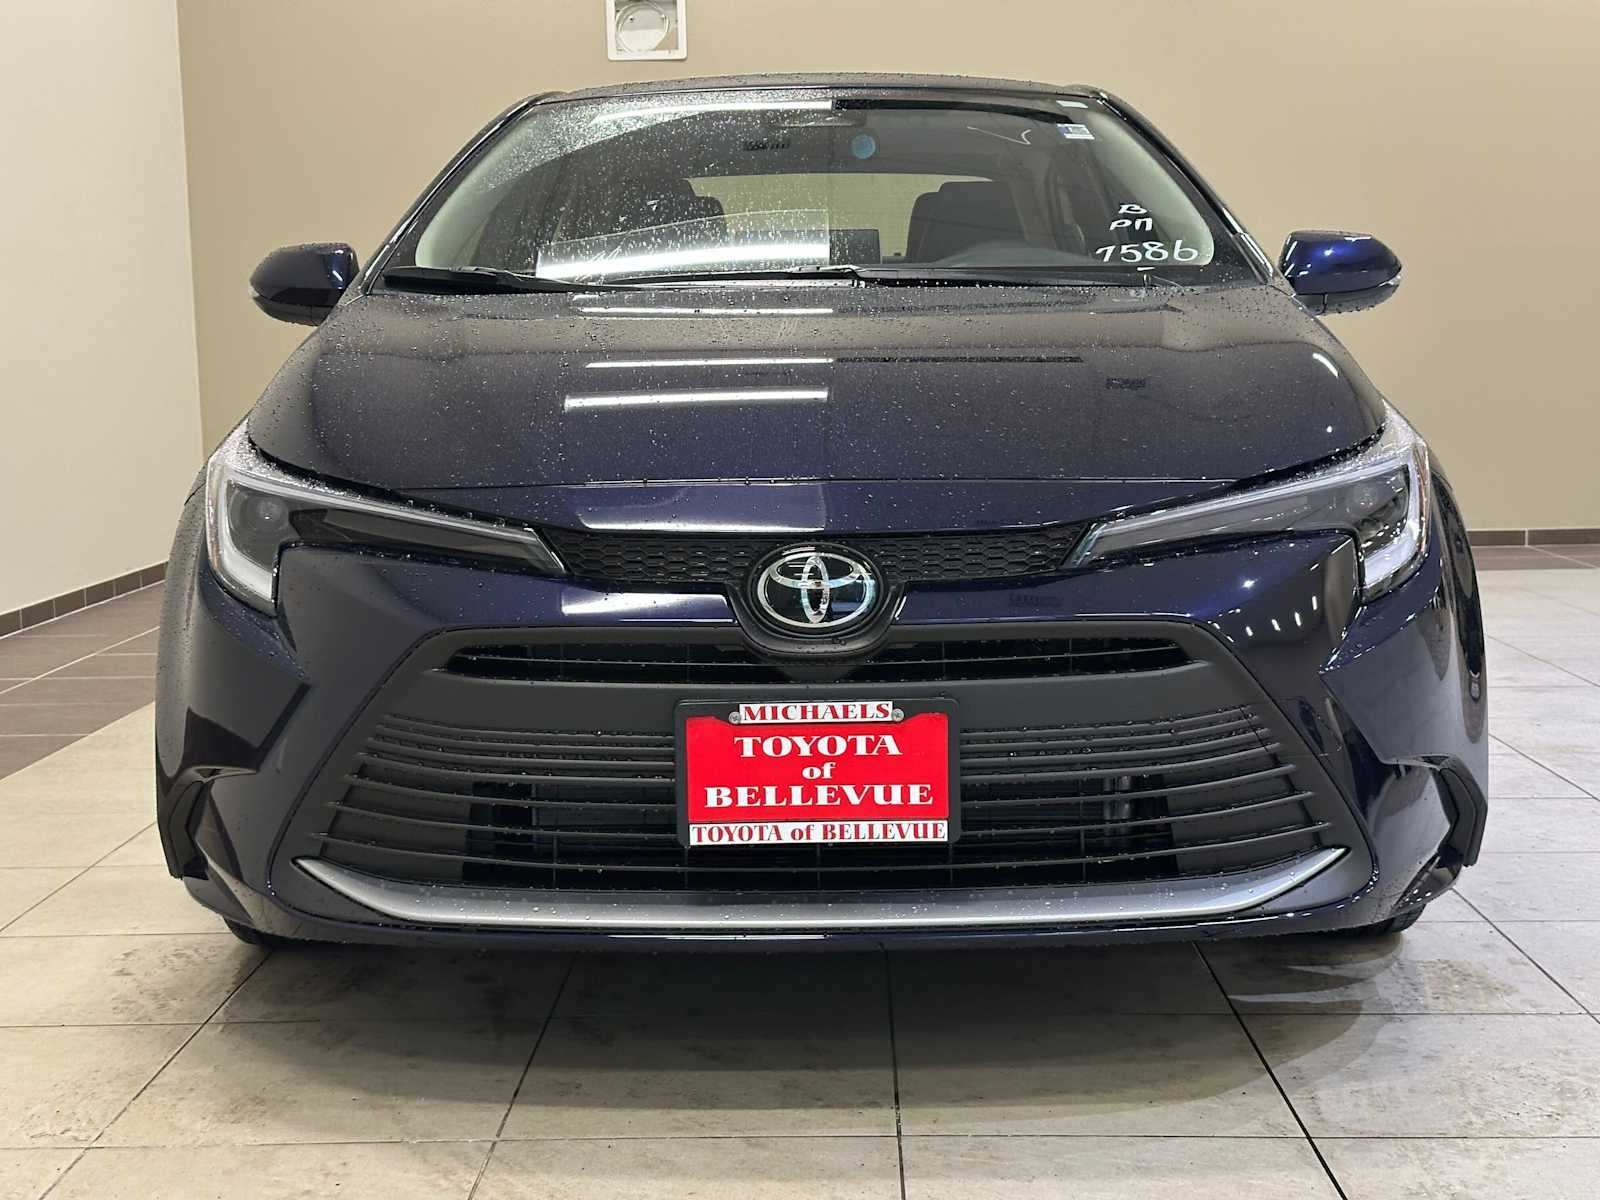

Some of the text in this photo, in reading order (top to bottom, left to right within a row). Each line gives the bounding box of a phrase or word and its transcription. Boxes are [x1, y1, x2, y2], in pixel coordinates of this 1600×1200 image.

[743, 703, 890, 721] MICHAELS
[734, 735, 902, 757] TOYOTA
[802, 762, 836, 779] of
[704, 784, 933, 807] BELLEVUE
[692, 823, 946, 843] TOYOTA of BELLEVUE
